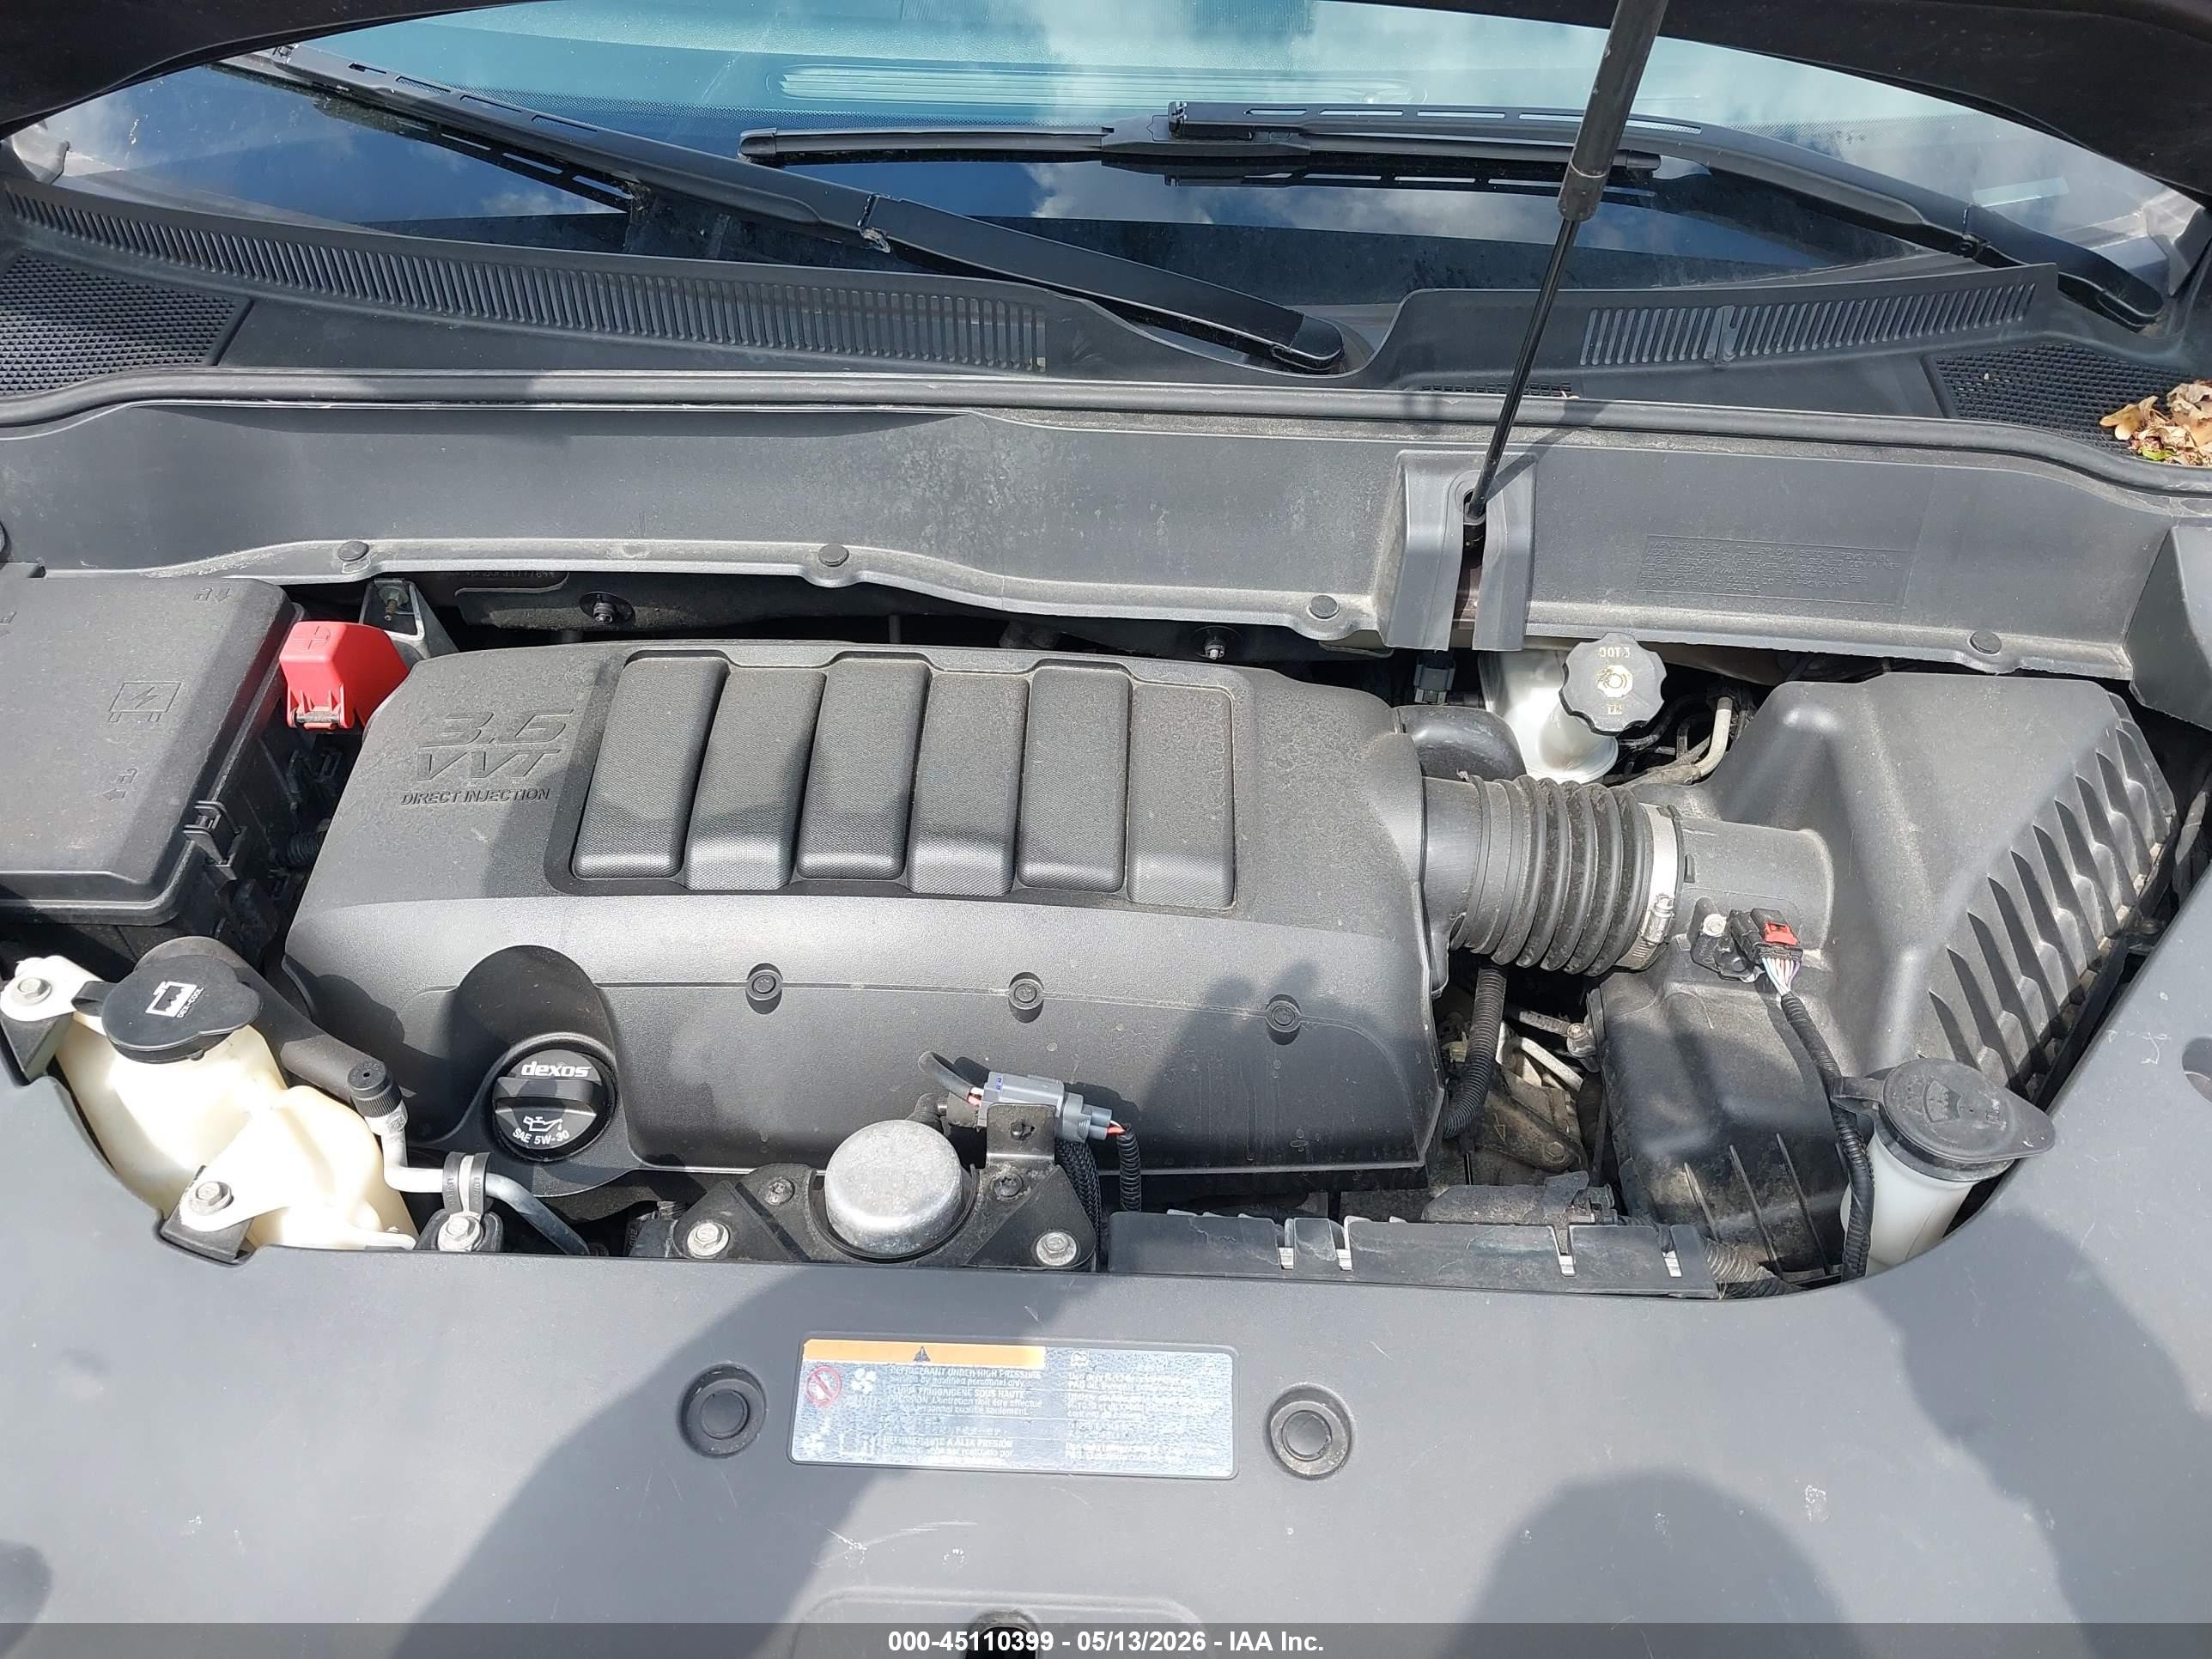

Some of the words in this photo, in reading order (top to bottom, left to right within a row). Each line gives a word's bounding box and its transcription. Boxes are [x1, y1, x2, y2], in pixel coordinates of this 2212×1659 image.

[1599, 647, 1621, 658] DOT
[420, 708, 574, 748] 3.6
[416, 749, 562, 781] VVT
[401, 790, 462, 805] DIRECT
[464, 787, 550, 804] INJECTION
[521, 1061, 592, 1077] dexos
[513, 1127, 532, 1144] SAE
[533, 1130, 570, 1146] 5W-30
